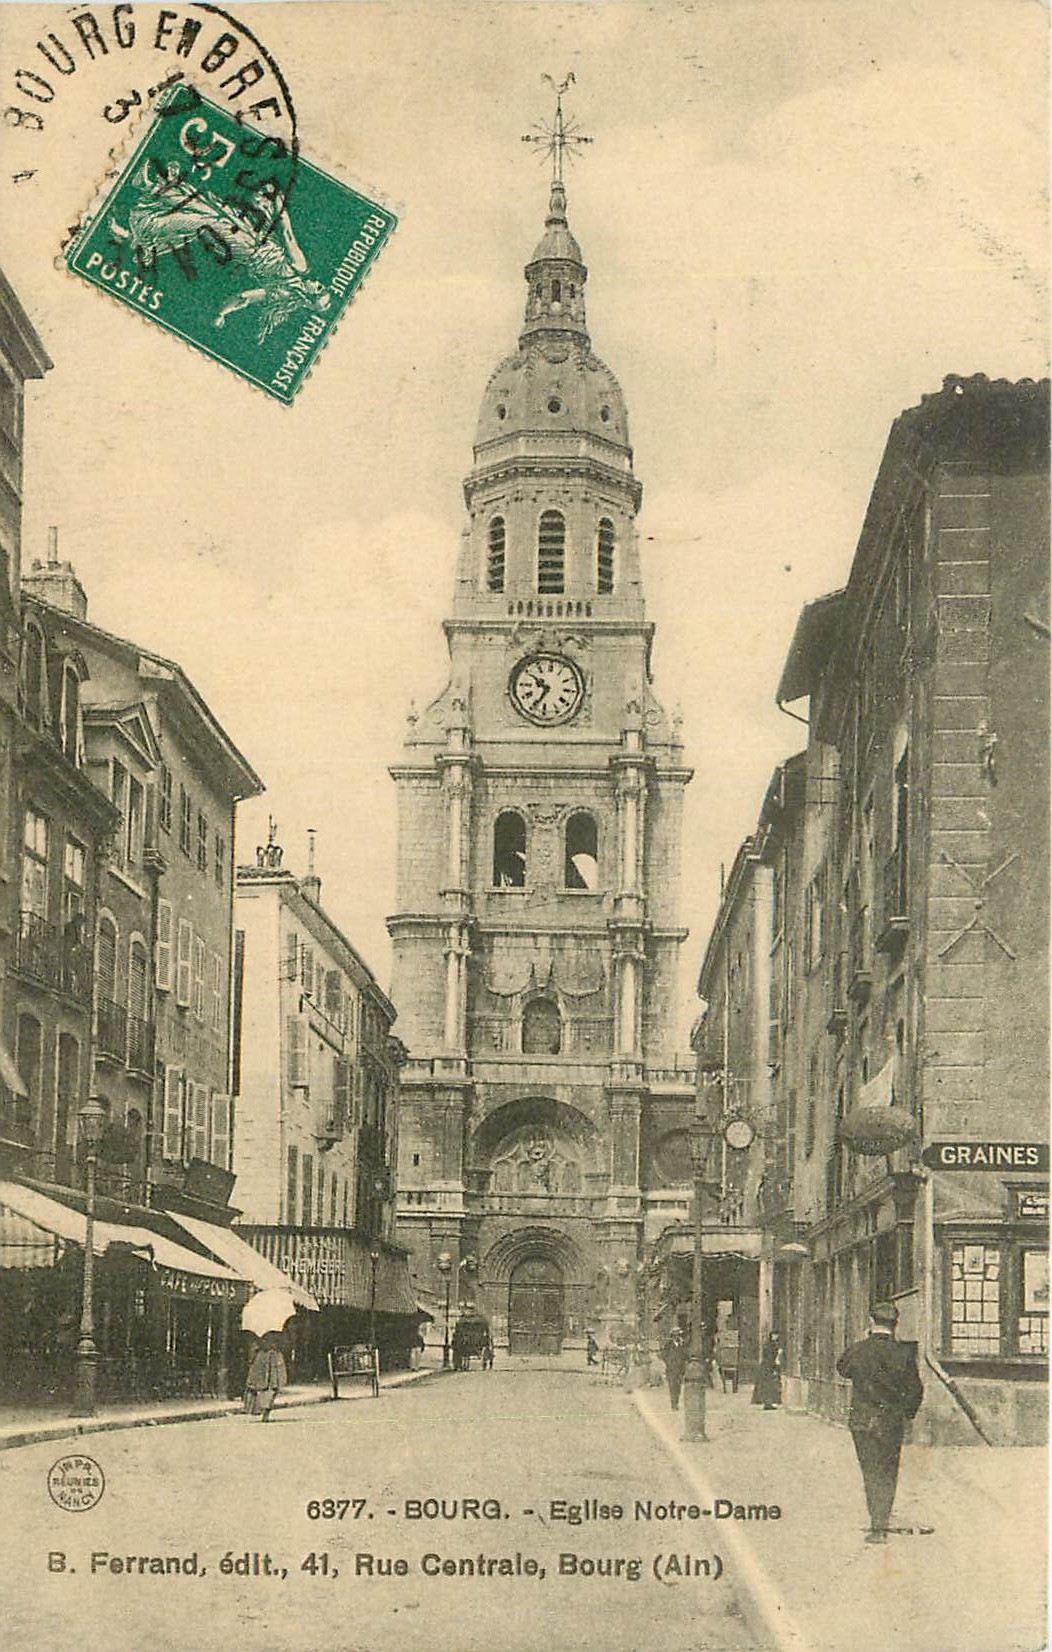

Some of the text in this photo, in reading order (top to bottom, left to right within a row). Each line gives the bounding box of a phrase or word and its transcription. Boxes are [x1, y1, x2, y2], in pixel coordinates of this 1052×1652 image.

[3, 3, 136, 131] BOURG
[85, 252, 163, 310] POSTES
[940, 1146, 1039, 1165] GRAINES
